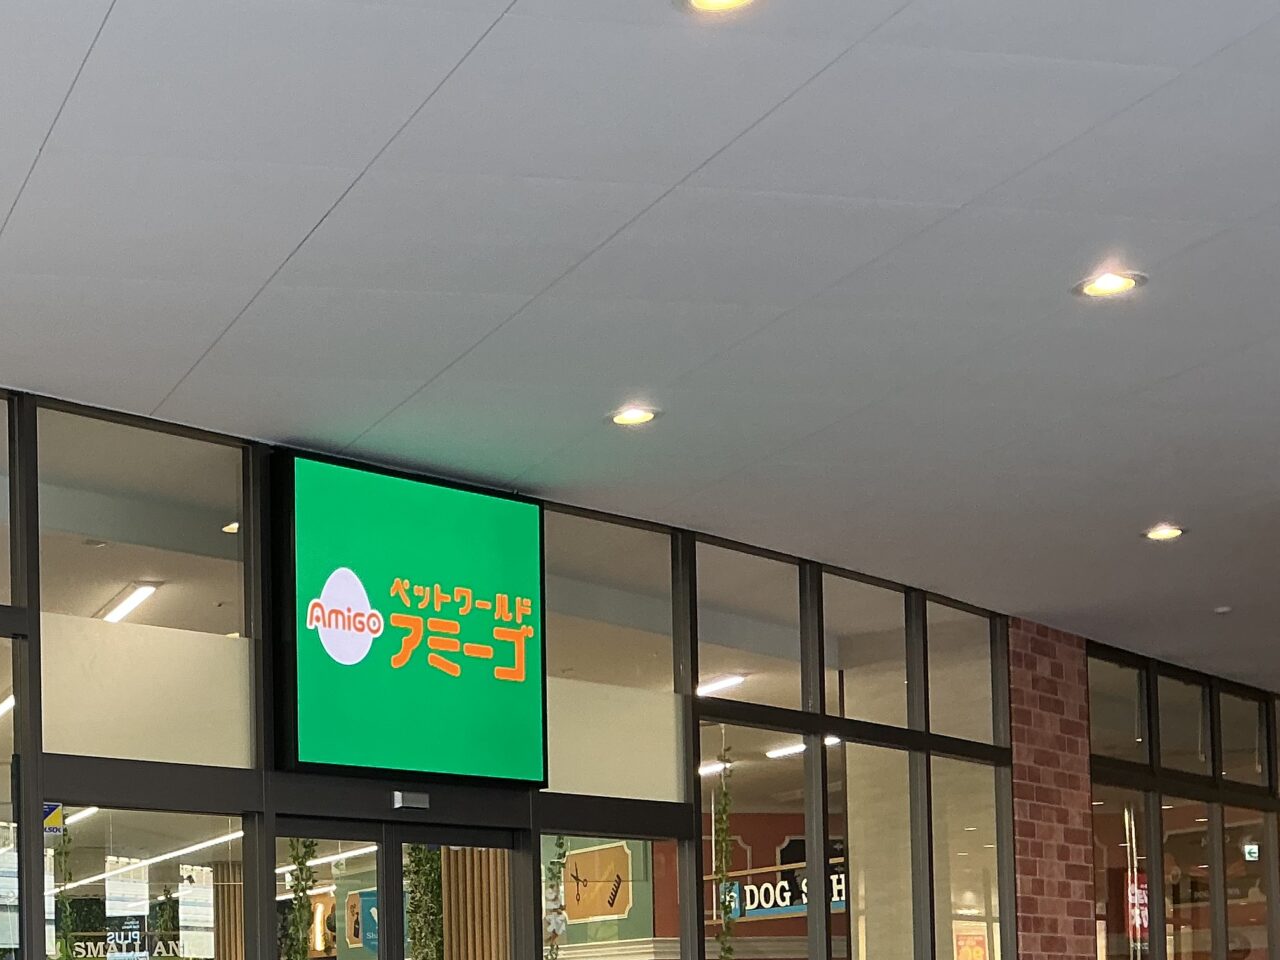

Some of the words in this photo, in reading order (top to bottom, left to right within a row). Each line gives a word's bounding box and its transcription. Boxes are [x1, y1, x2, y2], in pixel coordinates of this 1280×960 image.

[390, 577, 531, 623] ペットワールド
[390, 613, 534, 682] アミーゴ
[744, 880, 792, 911] DOG
